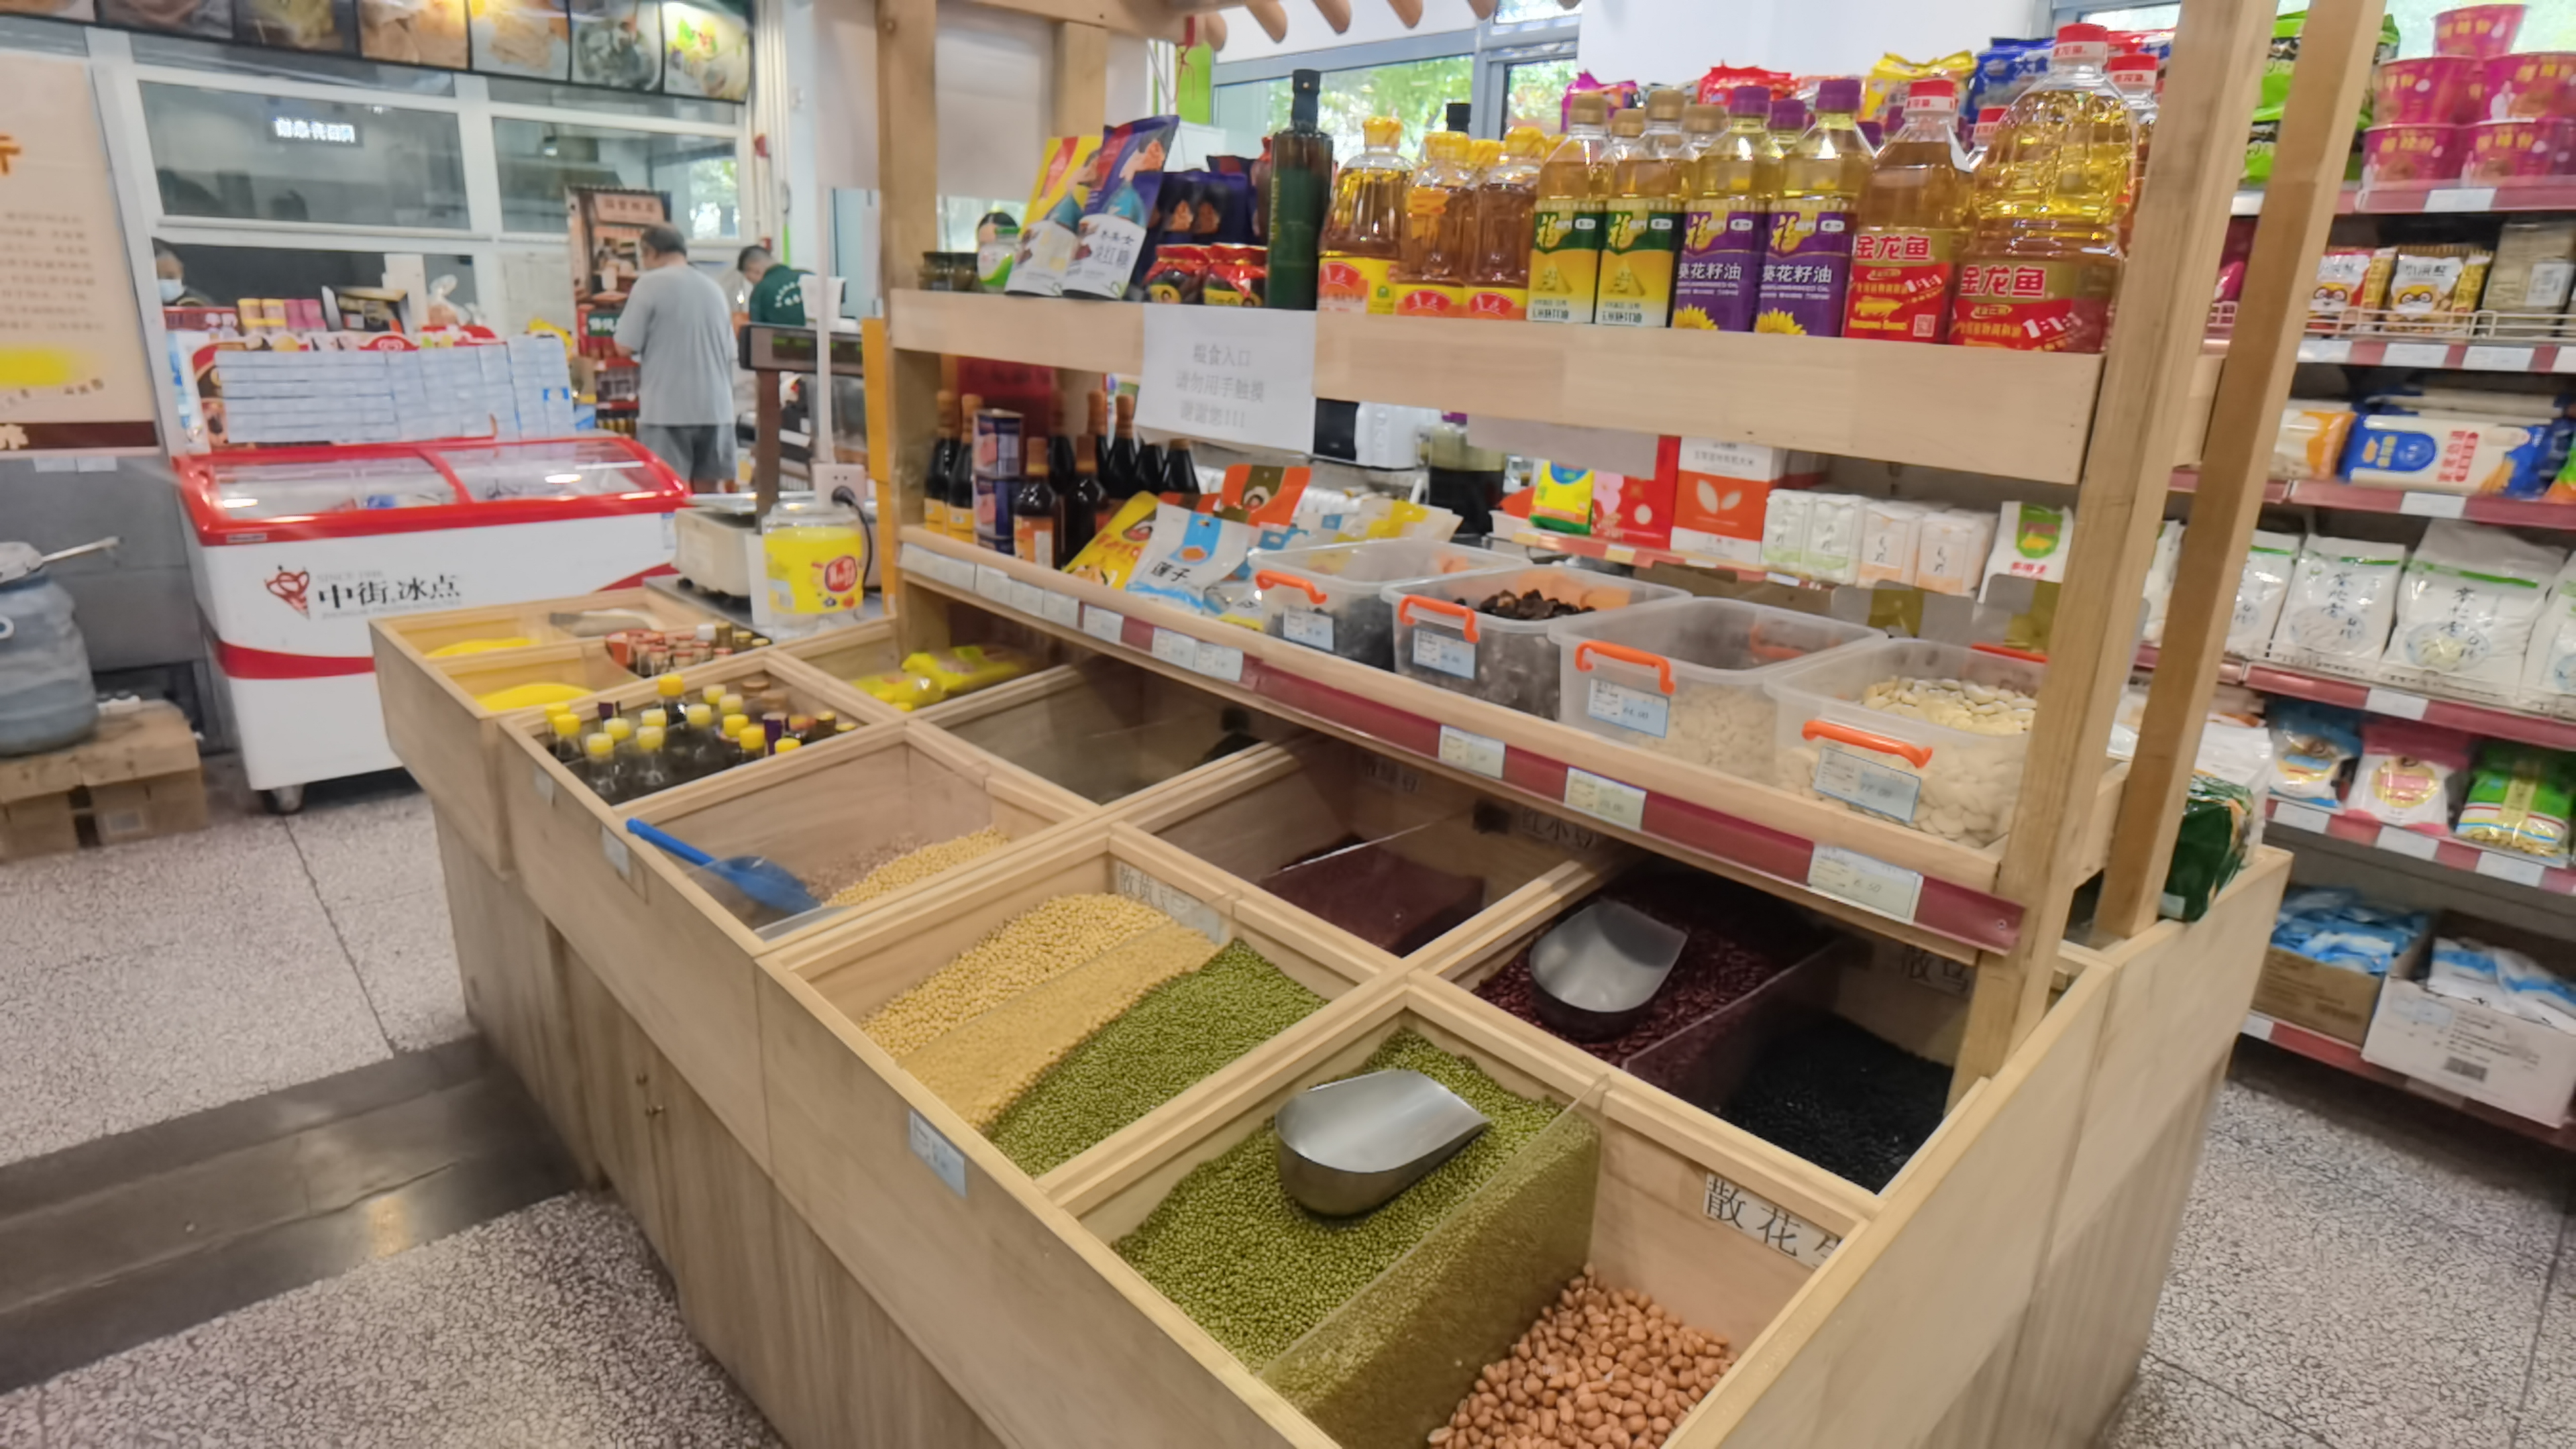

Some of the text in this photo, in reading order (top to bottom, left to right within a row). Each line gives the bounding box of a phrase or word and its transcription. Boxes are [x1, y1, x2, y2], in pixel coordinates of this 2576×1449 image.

[1856, 235, 1931, 262] 金龙鱼
[1677, 262, 1742, 281] 葵花籽油
[1762, 264, 1833, 284] 葵花籽油
[1960, 264, 2046, 299] 金龙鱼
